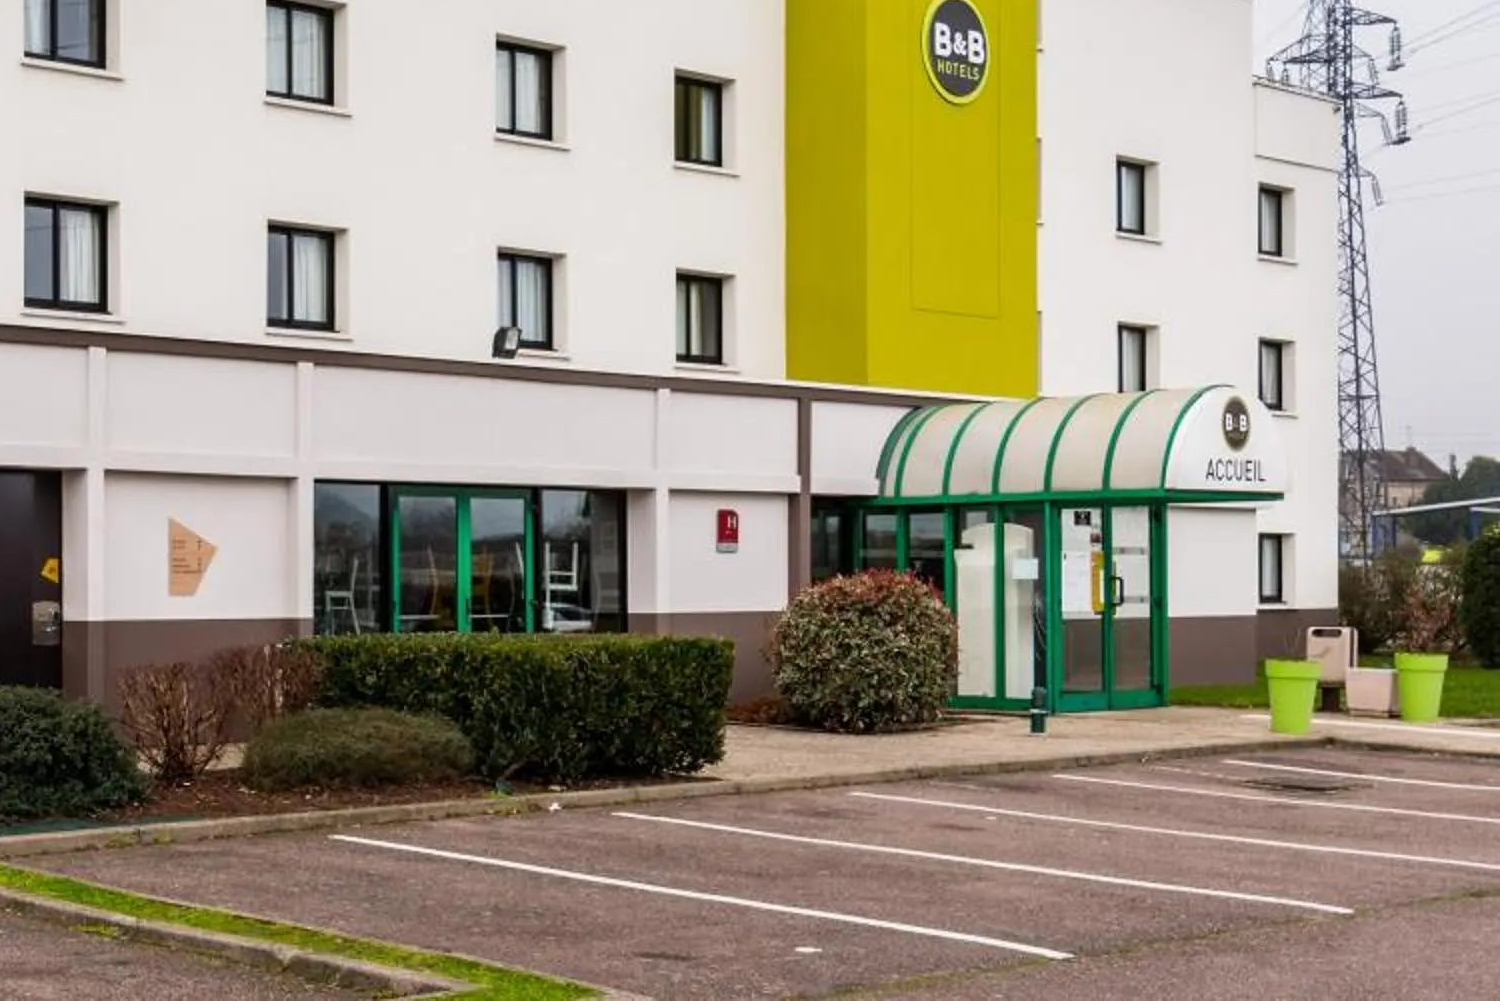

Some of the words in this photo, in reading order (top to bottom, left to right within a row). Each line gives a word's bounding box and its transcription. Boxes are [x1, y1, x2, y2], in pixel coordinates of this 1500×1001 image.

[935, 22, 985, 64] B&B
[937, 59, 980, 80] HOTELS
[1205, 458, 1266, 482] ACCUEIL
